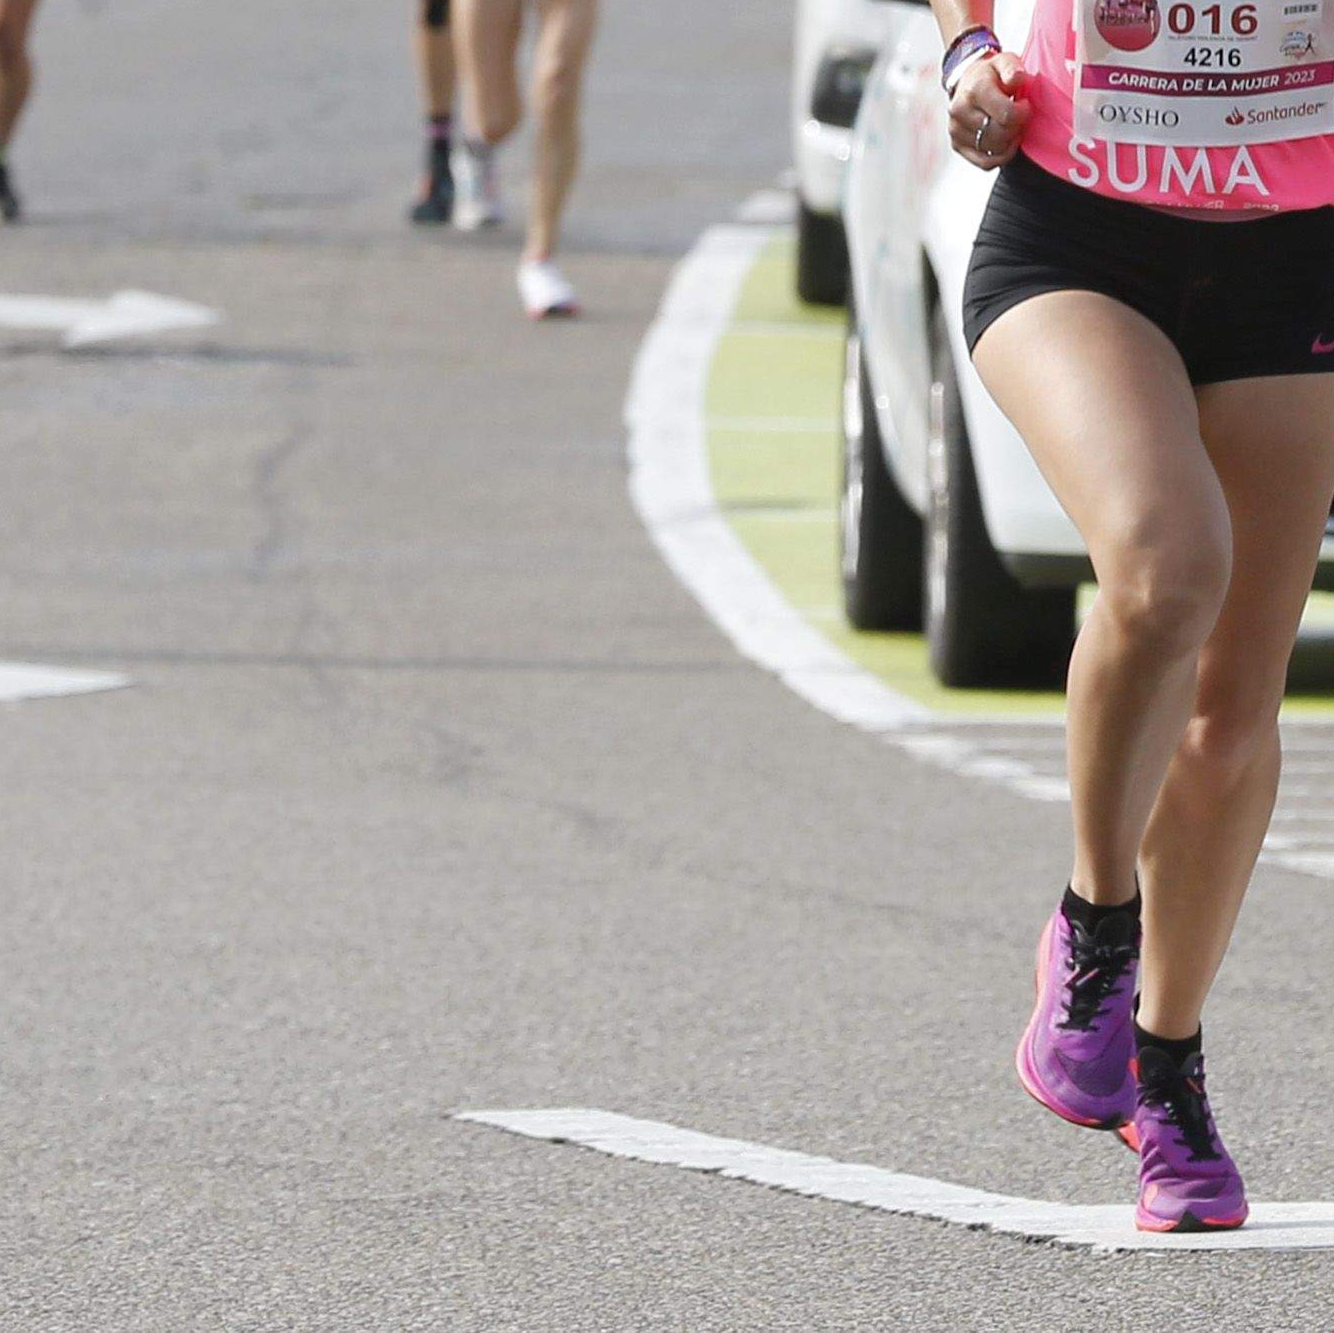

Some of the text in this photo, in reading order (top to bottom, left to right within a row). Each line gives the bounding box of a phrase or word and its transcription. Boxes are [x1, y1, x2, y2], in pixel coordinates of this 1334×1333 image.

[1168, 2, 1259, 35] 016
[1184, 47, 1242, 67] 4216
[1108, 69, 1316, 92] CARRERA DE LA MUJER 2023
[1099, 102, 1322, 128] OYSHO Santander
[1068, 137, 1270, 195] SUMA
